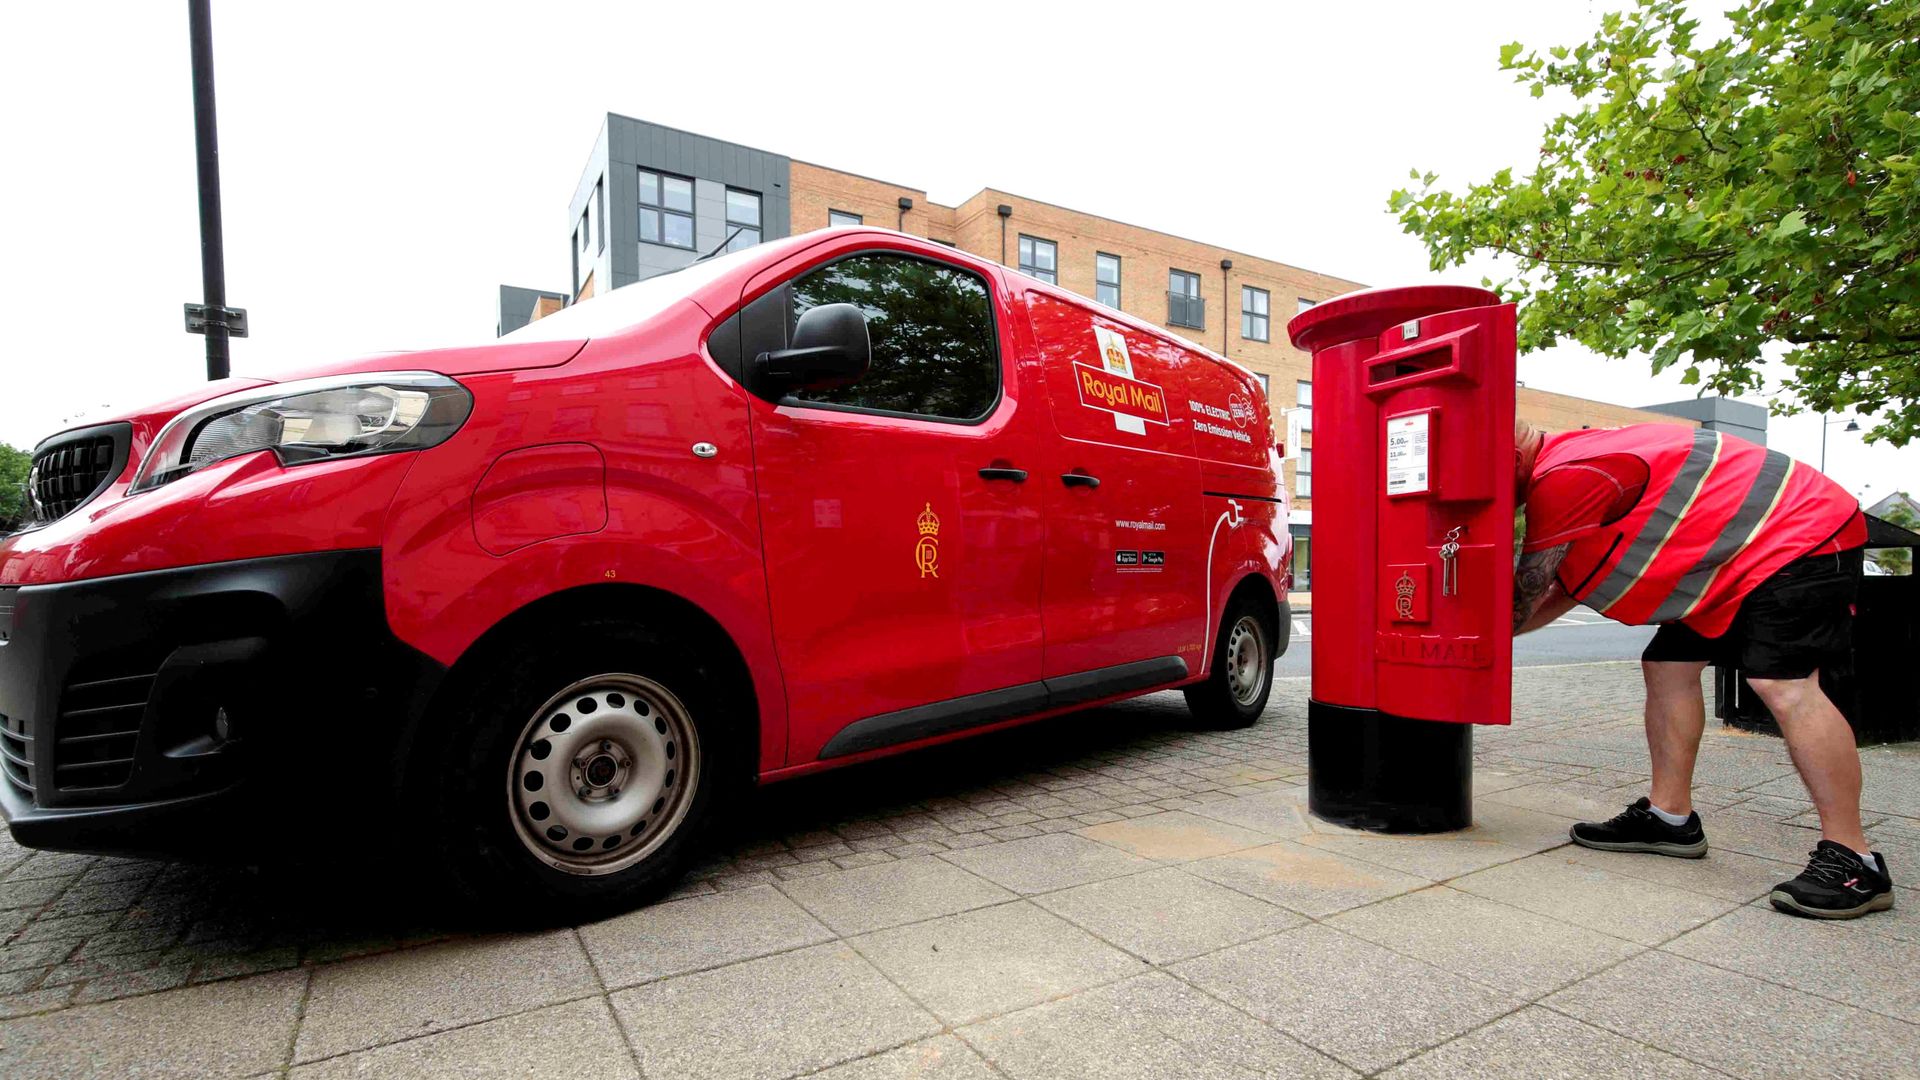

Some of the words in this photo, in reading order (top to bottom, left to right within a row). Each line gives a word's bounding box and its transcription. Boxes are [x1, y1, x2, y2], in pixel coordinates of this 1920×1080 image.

[1081, 371, 1129, 406] Royal
[1129, 385, 1162, 414] Mail
[1188, 399, 1206, 414] 100%
[1205, 405, 1231, 421] ELECTRIC
[1192, 419, 1208, 433] Zero
[1207, 422, 1233, 439] Emission
[1231, 429, 1252, 444] Vehicle
[1115, 519, 1166, 531] www.royalmail.com
[604, 569, 616, 578] 43
[1420, 641, 1486, 662] MAIL
